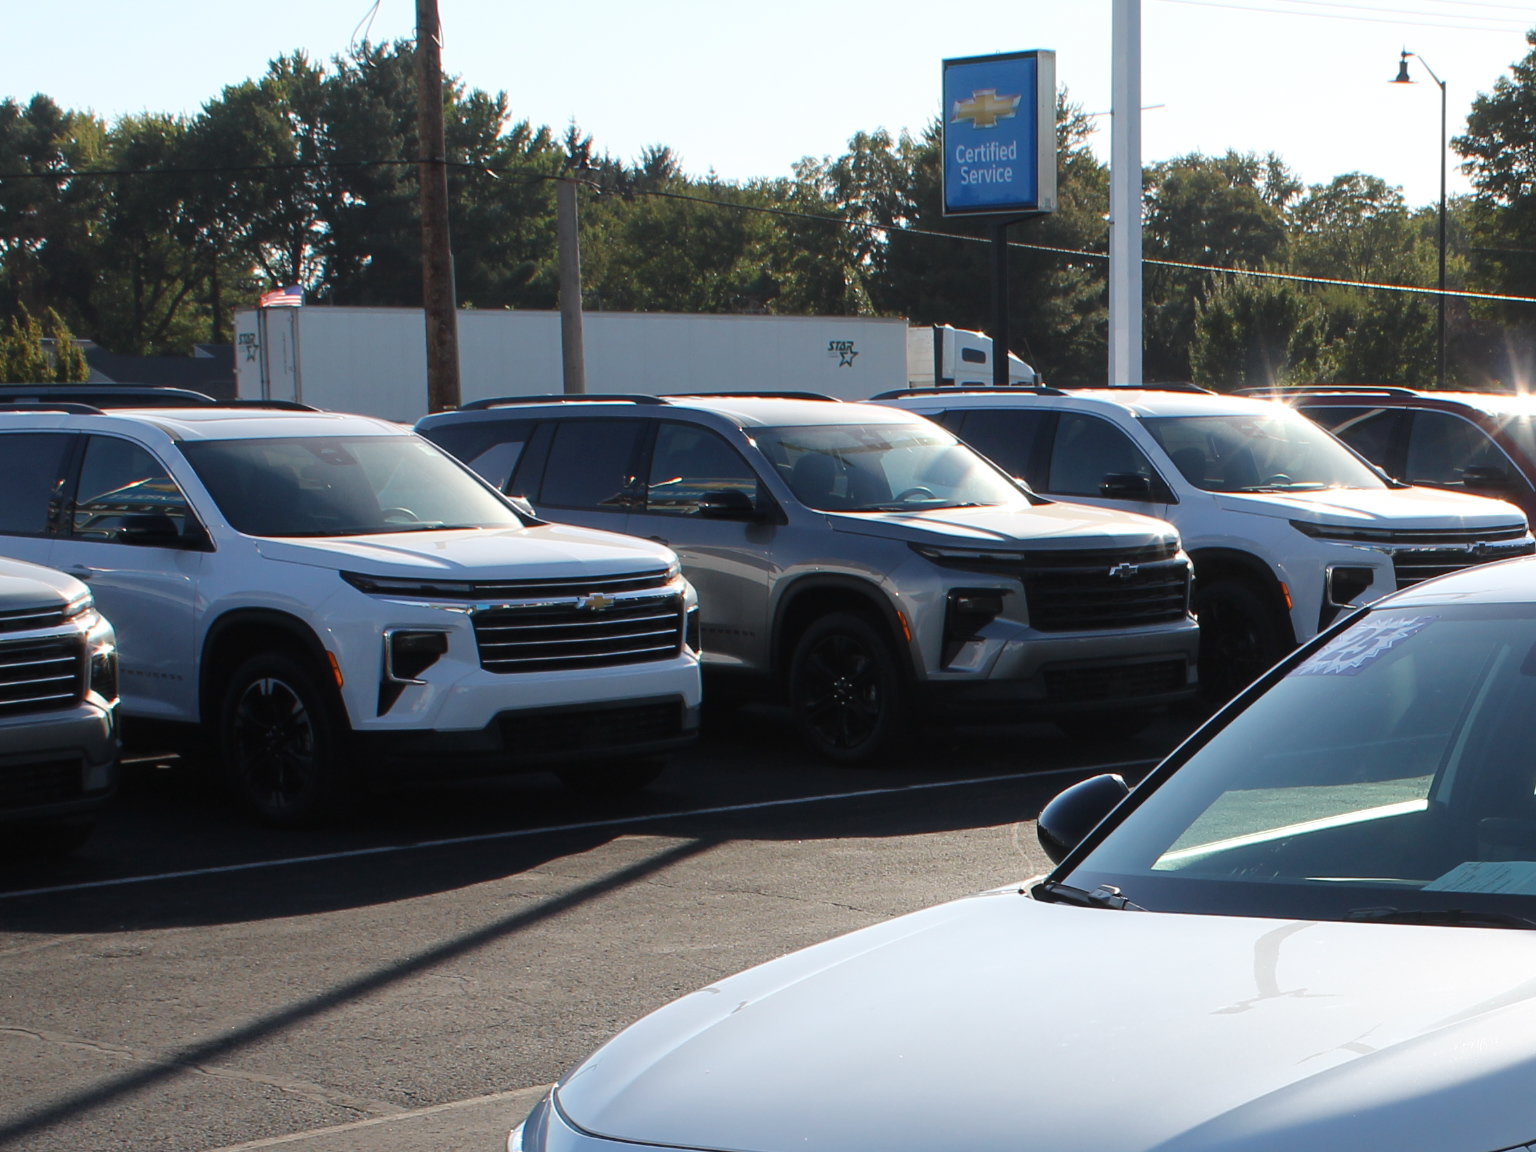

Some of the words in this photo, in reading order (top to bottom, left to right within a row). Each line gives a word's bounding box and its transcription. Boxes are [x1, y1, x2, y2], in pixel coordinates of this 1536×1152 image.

[955, 141, 1017, 163] Certified
[960, 164, 1013, 184] Service
[827, 341, 855, 352] STAR
[1316, 627, 1402, 662] 25
